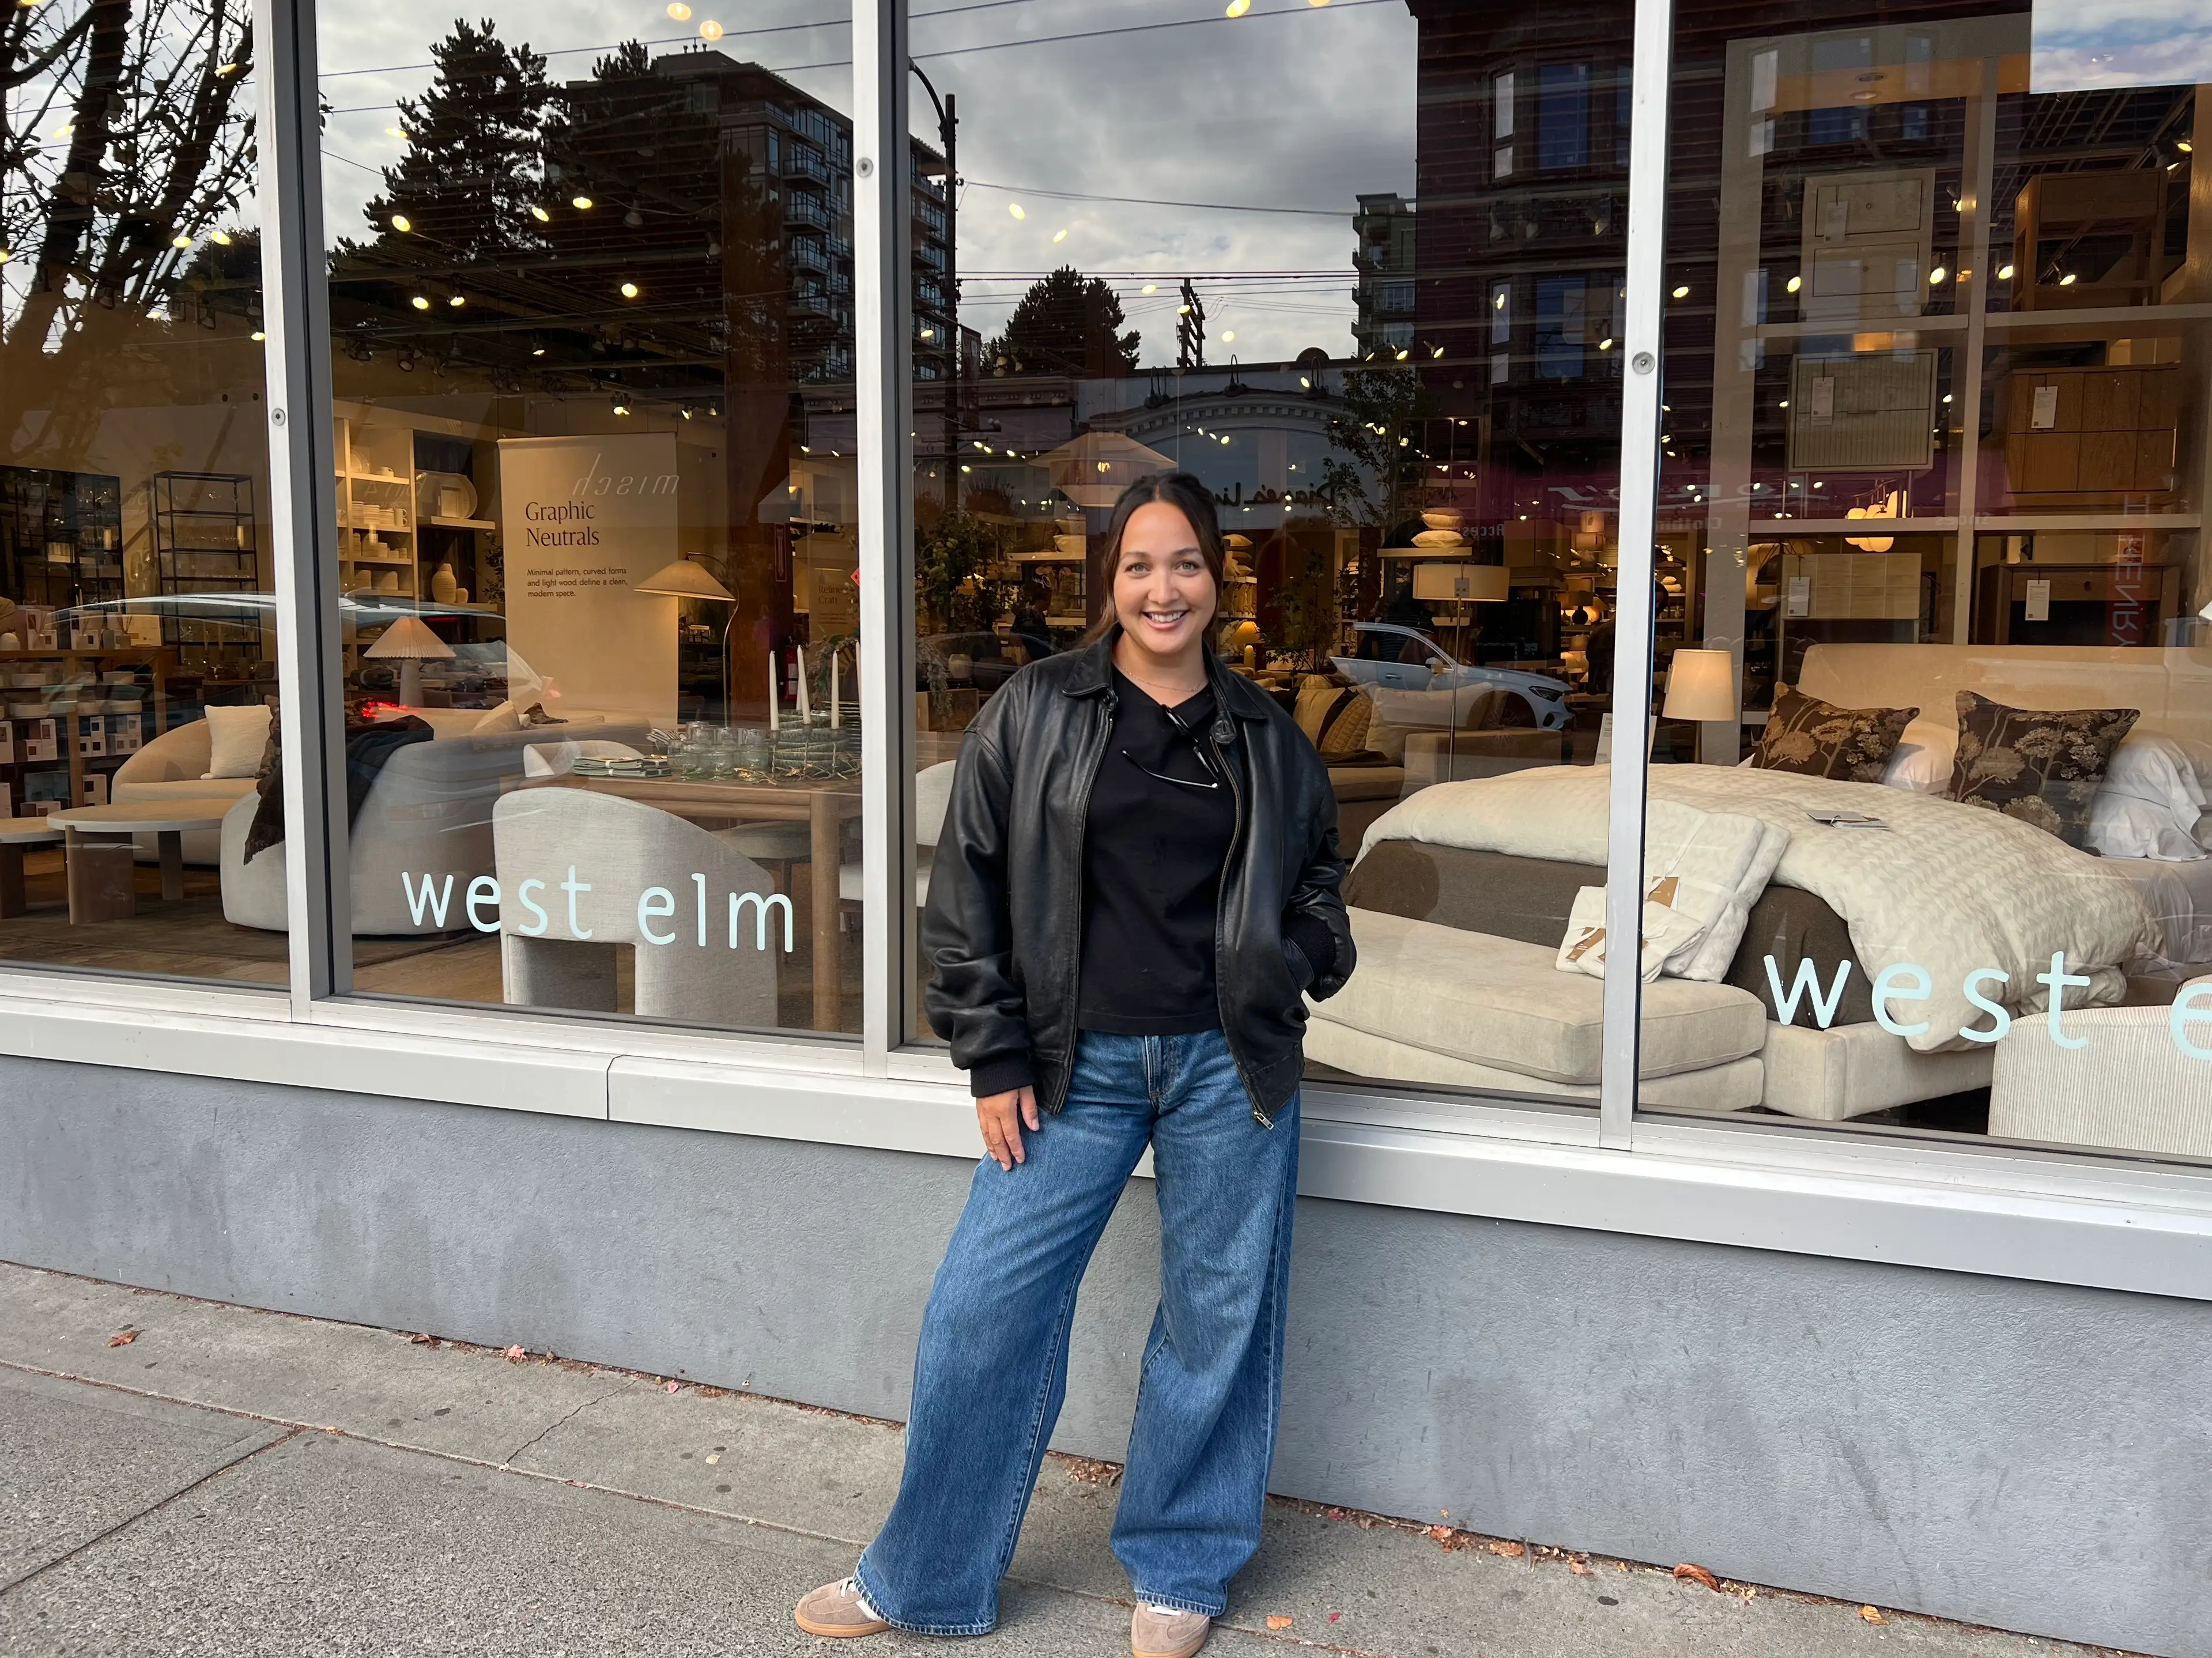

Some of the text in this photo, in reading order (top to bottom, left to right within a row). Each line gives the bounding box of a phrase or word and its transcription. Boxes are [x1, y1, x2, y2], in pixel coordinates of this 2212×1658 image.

[525, 500, 595, 524] Graphic
[526, 526, 599, 547] Neutrals
[542, 579, 557, 588] light
[579, 577, 601, 586] define
[609, 577, 628, 586] clean,
[555, 568, 581, 577] pattern,
[608, 567, 627, 575] forms
[818, 596, 839, 605] Craft
[401, 864, 794, 953] west elm
[1762, 950, 2091, 1050] west
